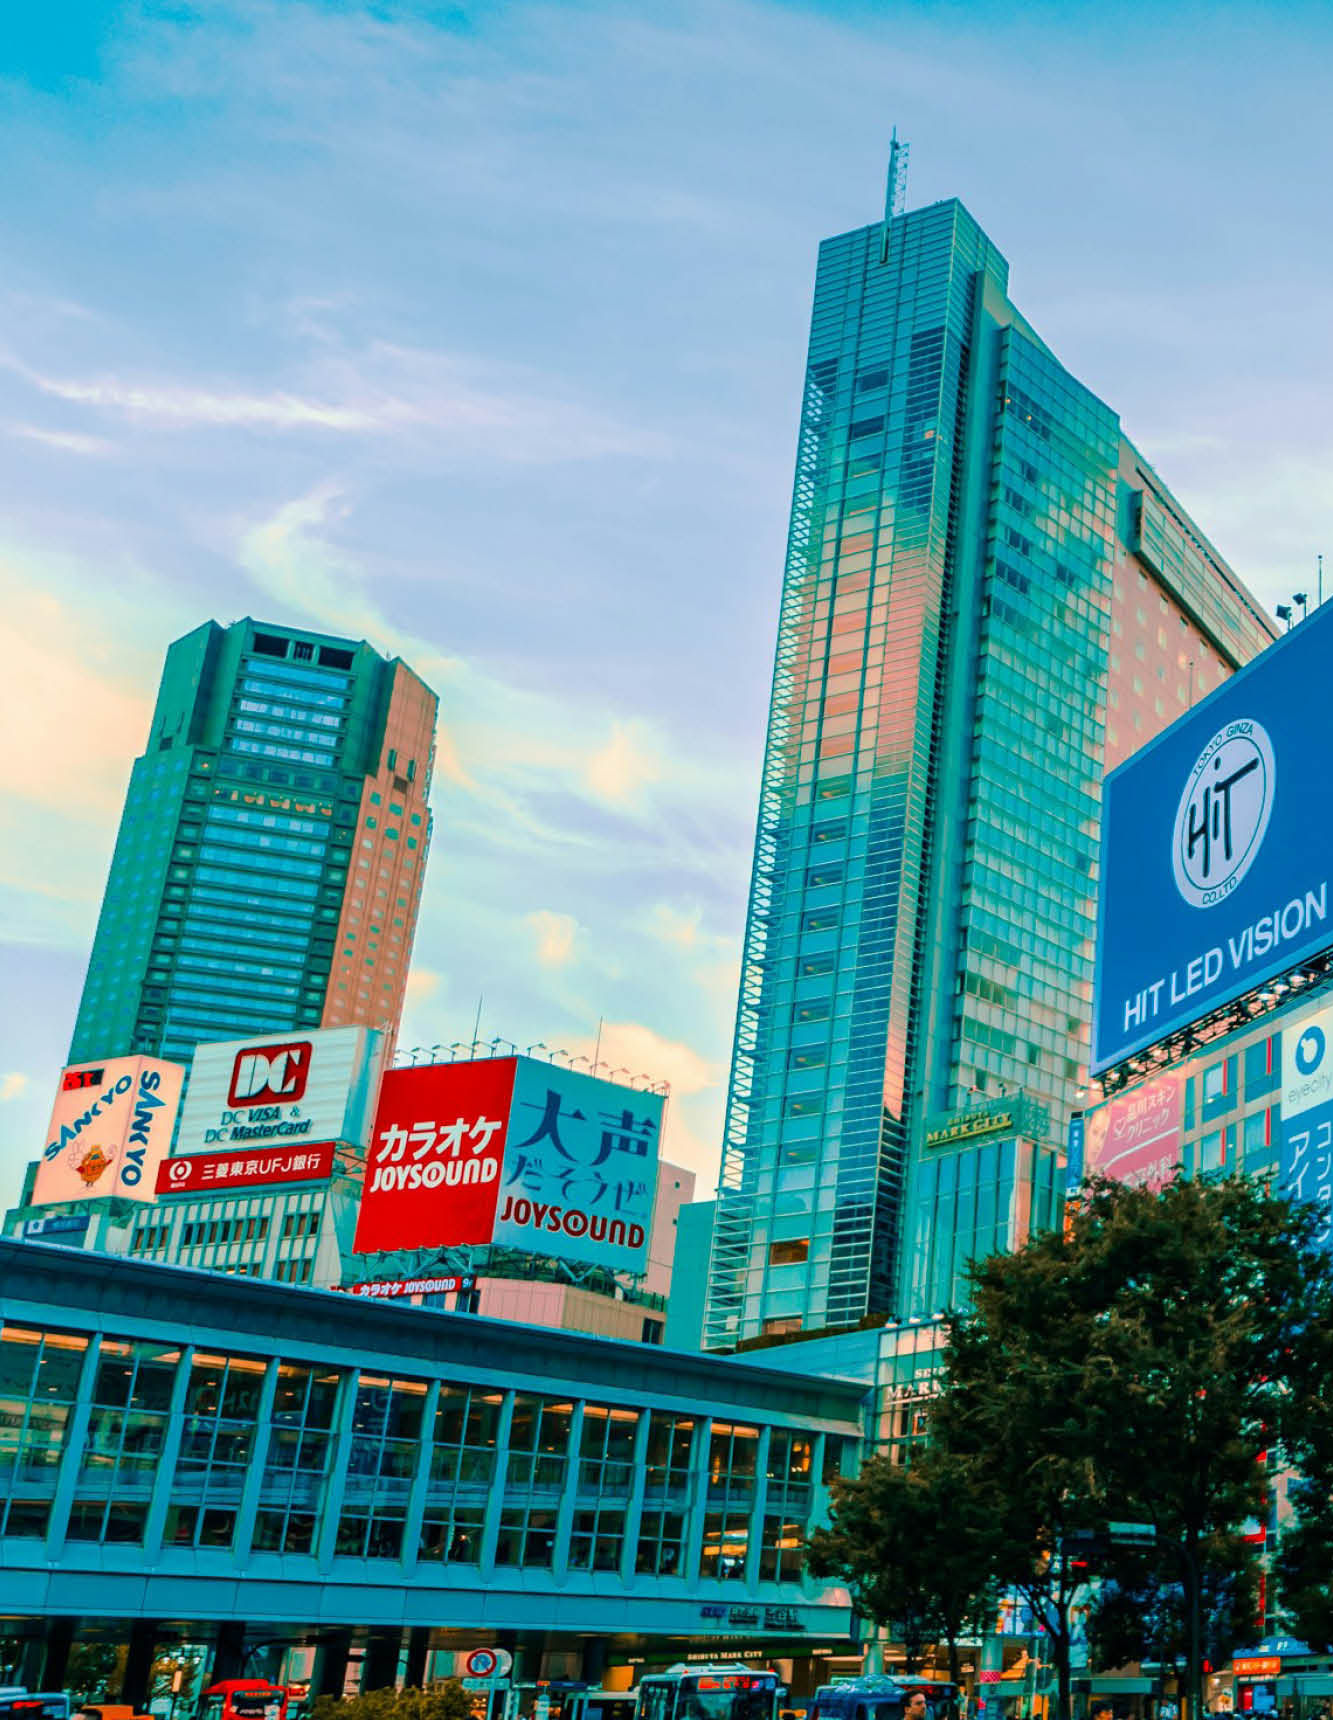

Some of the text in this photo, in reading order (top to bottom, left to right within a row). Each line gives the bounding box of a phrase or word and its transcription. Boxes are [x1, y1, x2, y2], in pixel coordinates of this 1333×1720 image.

[1193, 722, 1255, 776] TOKYO GINZA
[1124, 881, 1329, 1033] HIT LED VISION
[120, 1070, 168, 1187] SANKYO
[204, 1119, 311, 1143] DC MasterCard
[221, 1110, 244, 1126] DC
[247, 1107, 281, 1123] VISA
[513, 1088, 658, 1167] 大声
[926, 1123, 969, 1144] MARK
[376, 1115, 502, 1164] カラオケ
[201, 1152, 322, 1181] 三菱東京UFJ銀行
[369, 1157, 499, 1193] JOYSOUND
[500, 1195, 645, 1249] JOYSOUND
[360, 1282, 402, 1297] カラオケ
[404, 1278, 456, 1294] JOYSOUND
